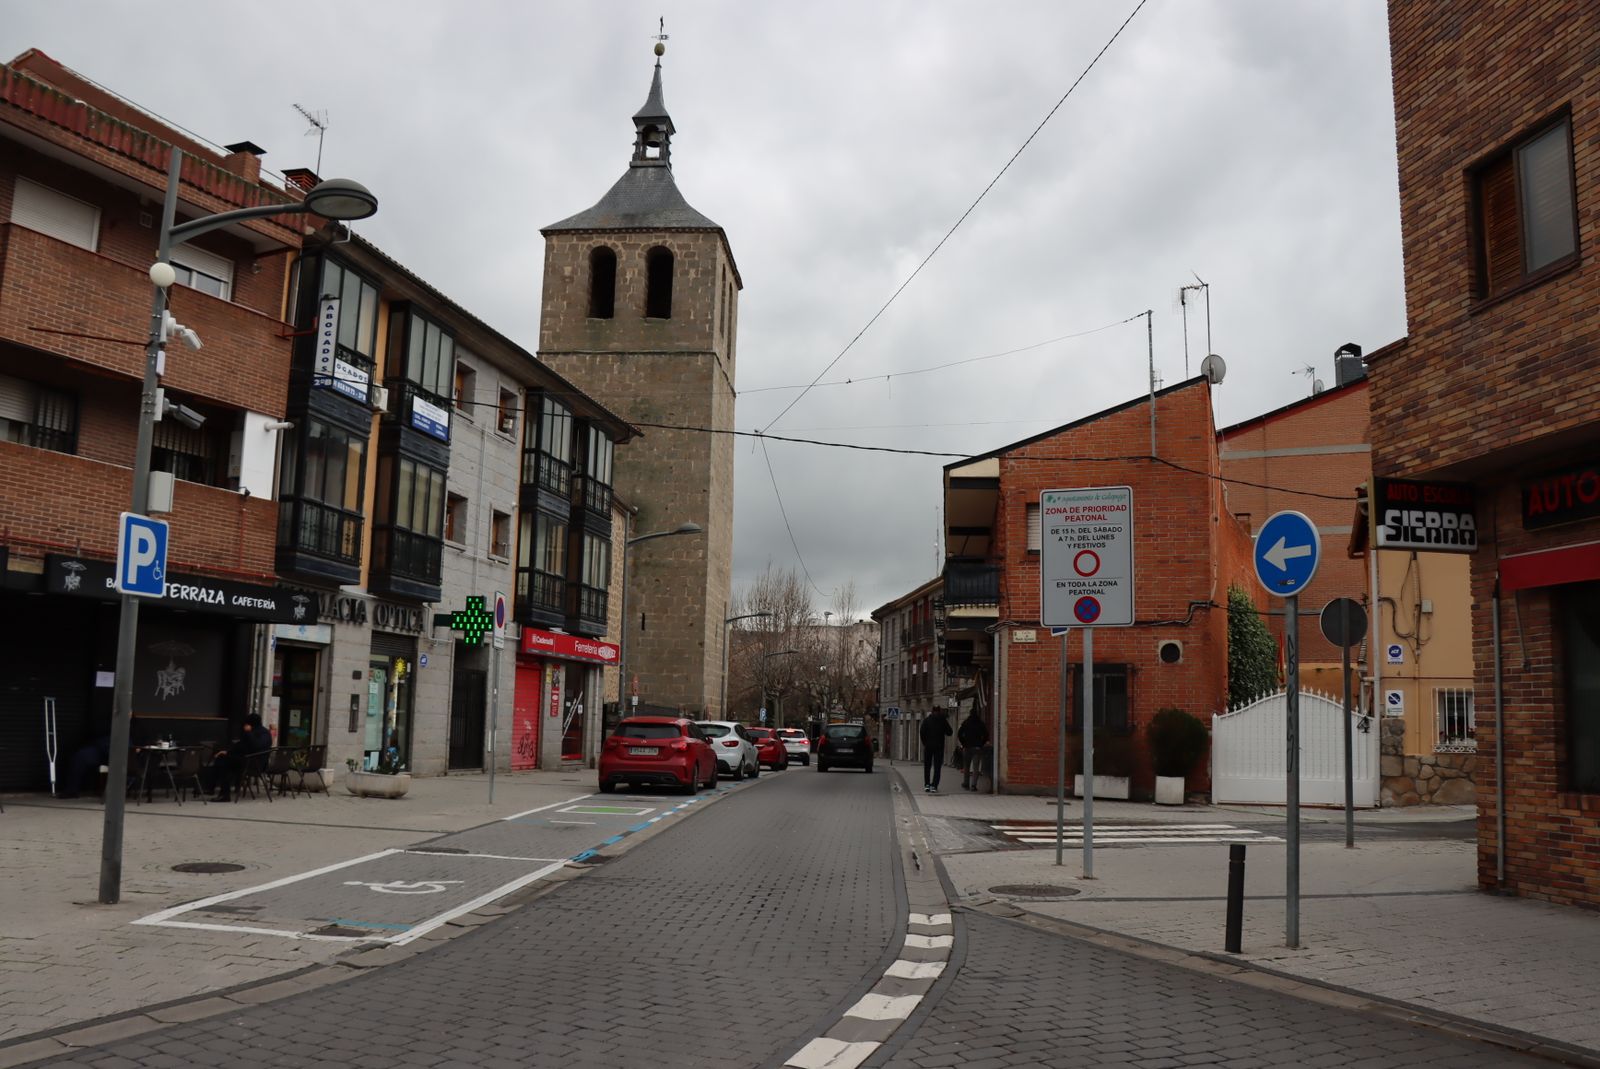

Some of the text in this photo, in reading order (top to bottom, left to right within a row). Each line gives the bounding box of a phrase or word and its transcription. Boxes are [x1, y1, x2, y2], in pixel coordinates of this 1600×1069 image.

[321, 304, 335, 372] ABOGADOS
[1386, 482, 1419, 503] AUTO
[1045, 505, 1127, 515] ZONA DE PRIORIDAD
[1064, 514, 1108, 522] PEATONAL
[1385, 509, 1476, 545] SIERRA
[127, 524, 157, 584] P
